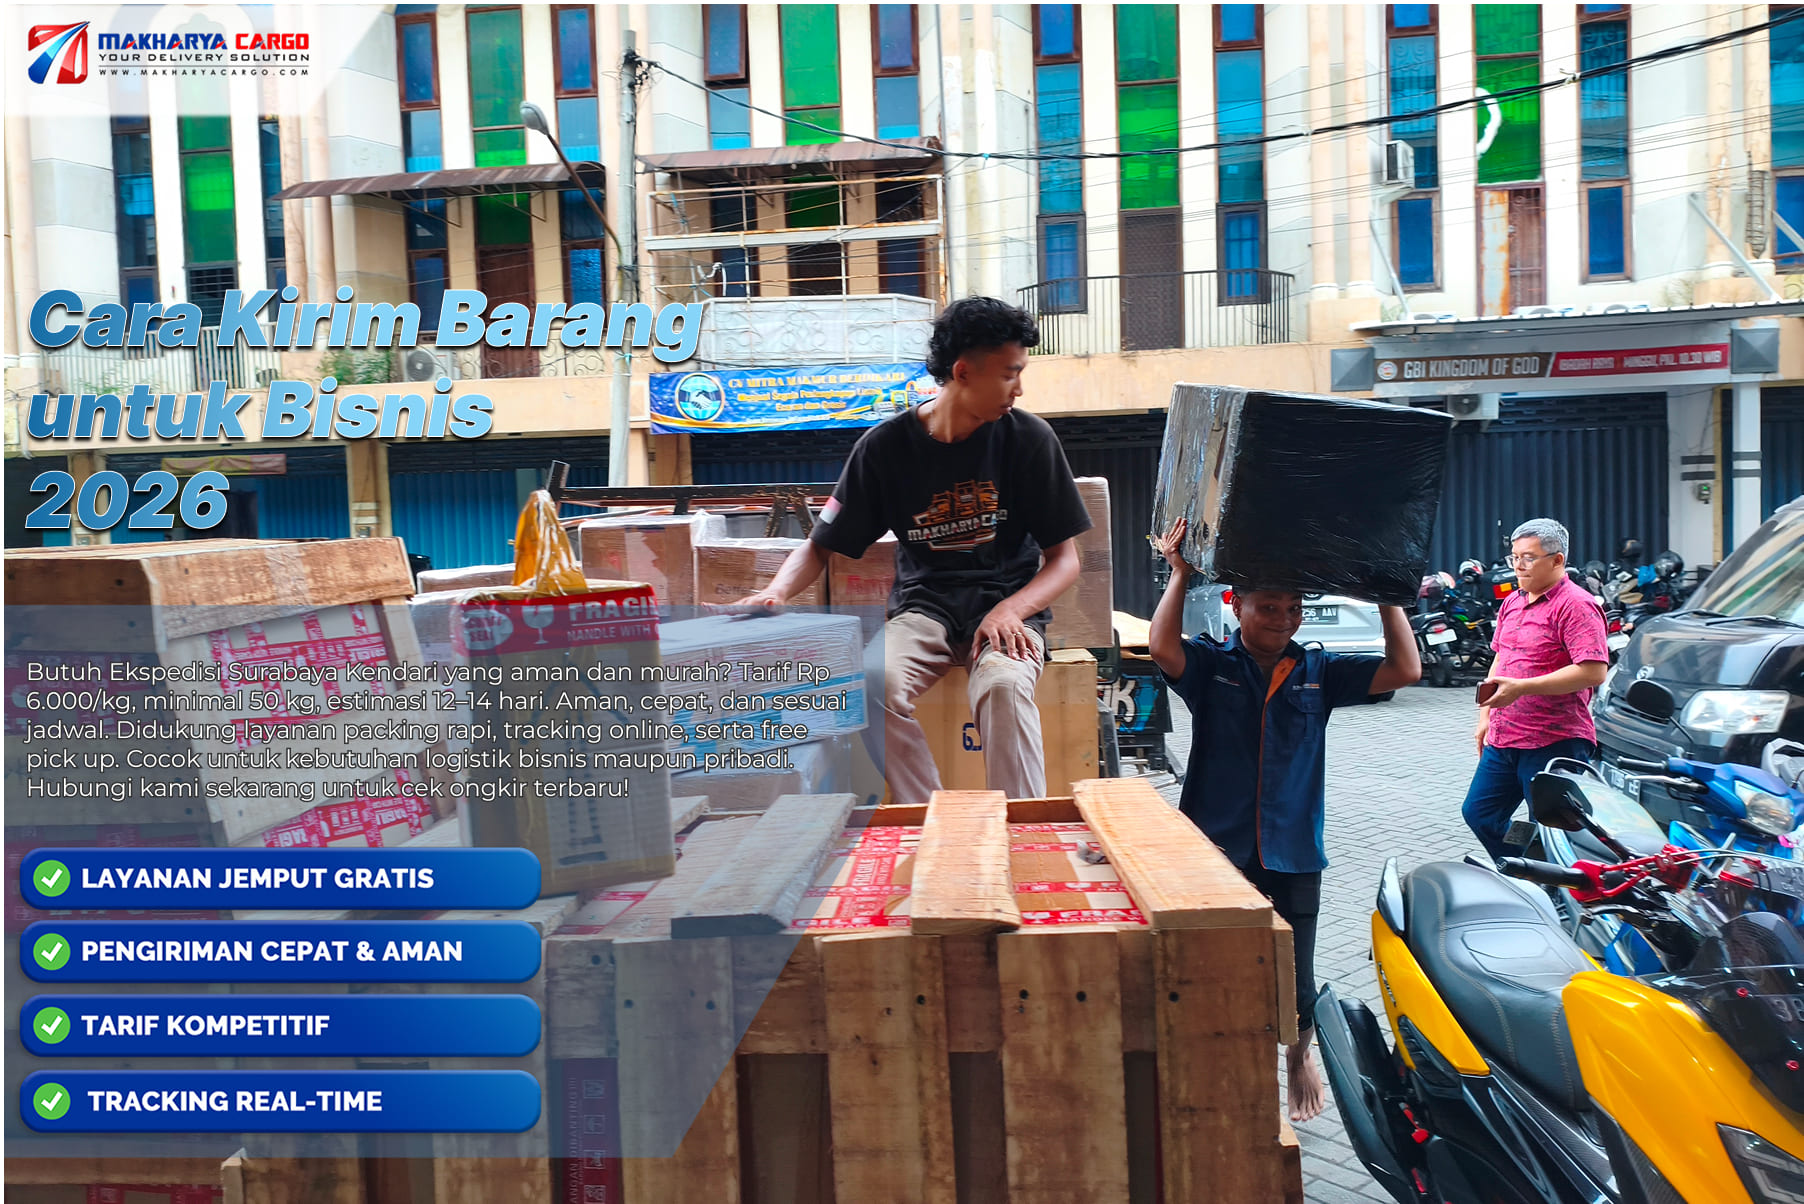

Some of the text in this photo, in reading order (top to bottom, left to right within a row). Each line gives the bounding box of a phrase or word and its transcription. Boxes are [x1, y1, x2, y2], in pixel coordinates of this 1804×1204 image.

[1404, 356, 1540, 378] GBI KINGDOM OF GOD
[907, 518, 980, 541] MAKHARYA
[621, 624, 651, 638] WITH
[796, 917, 872, 925] GILE
[568, 1163, 579, 1203] ANGAN
